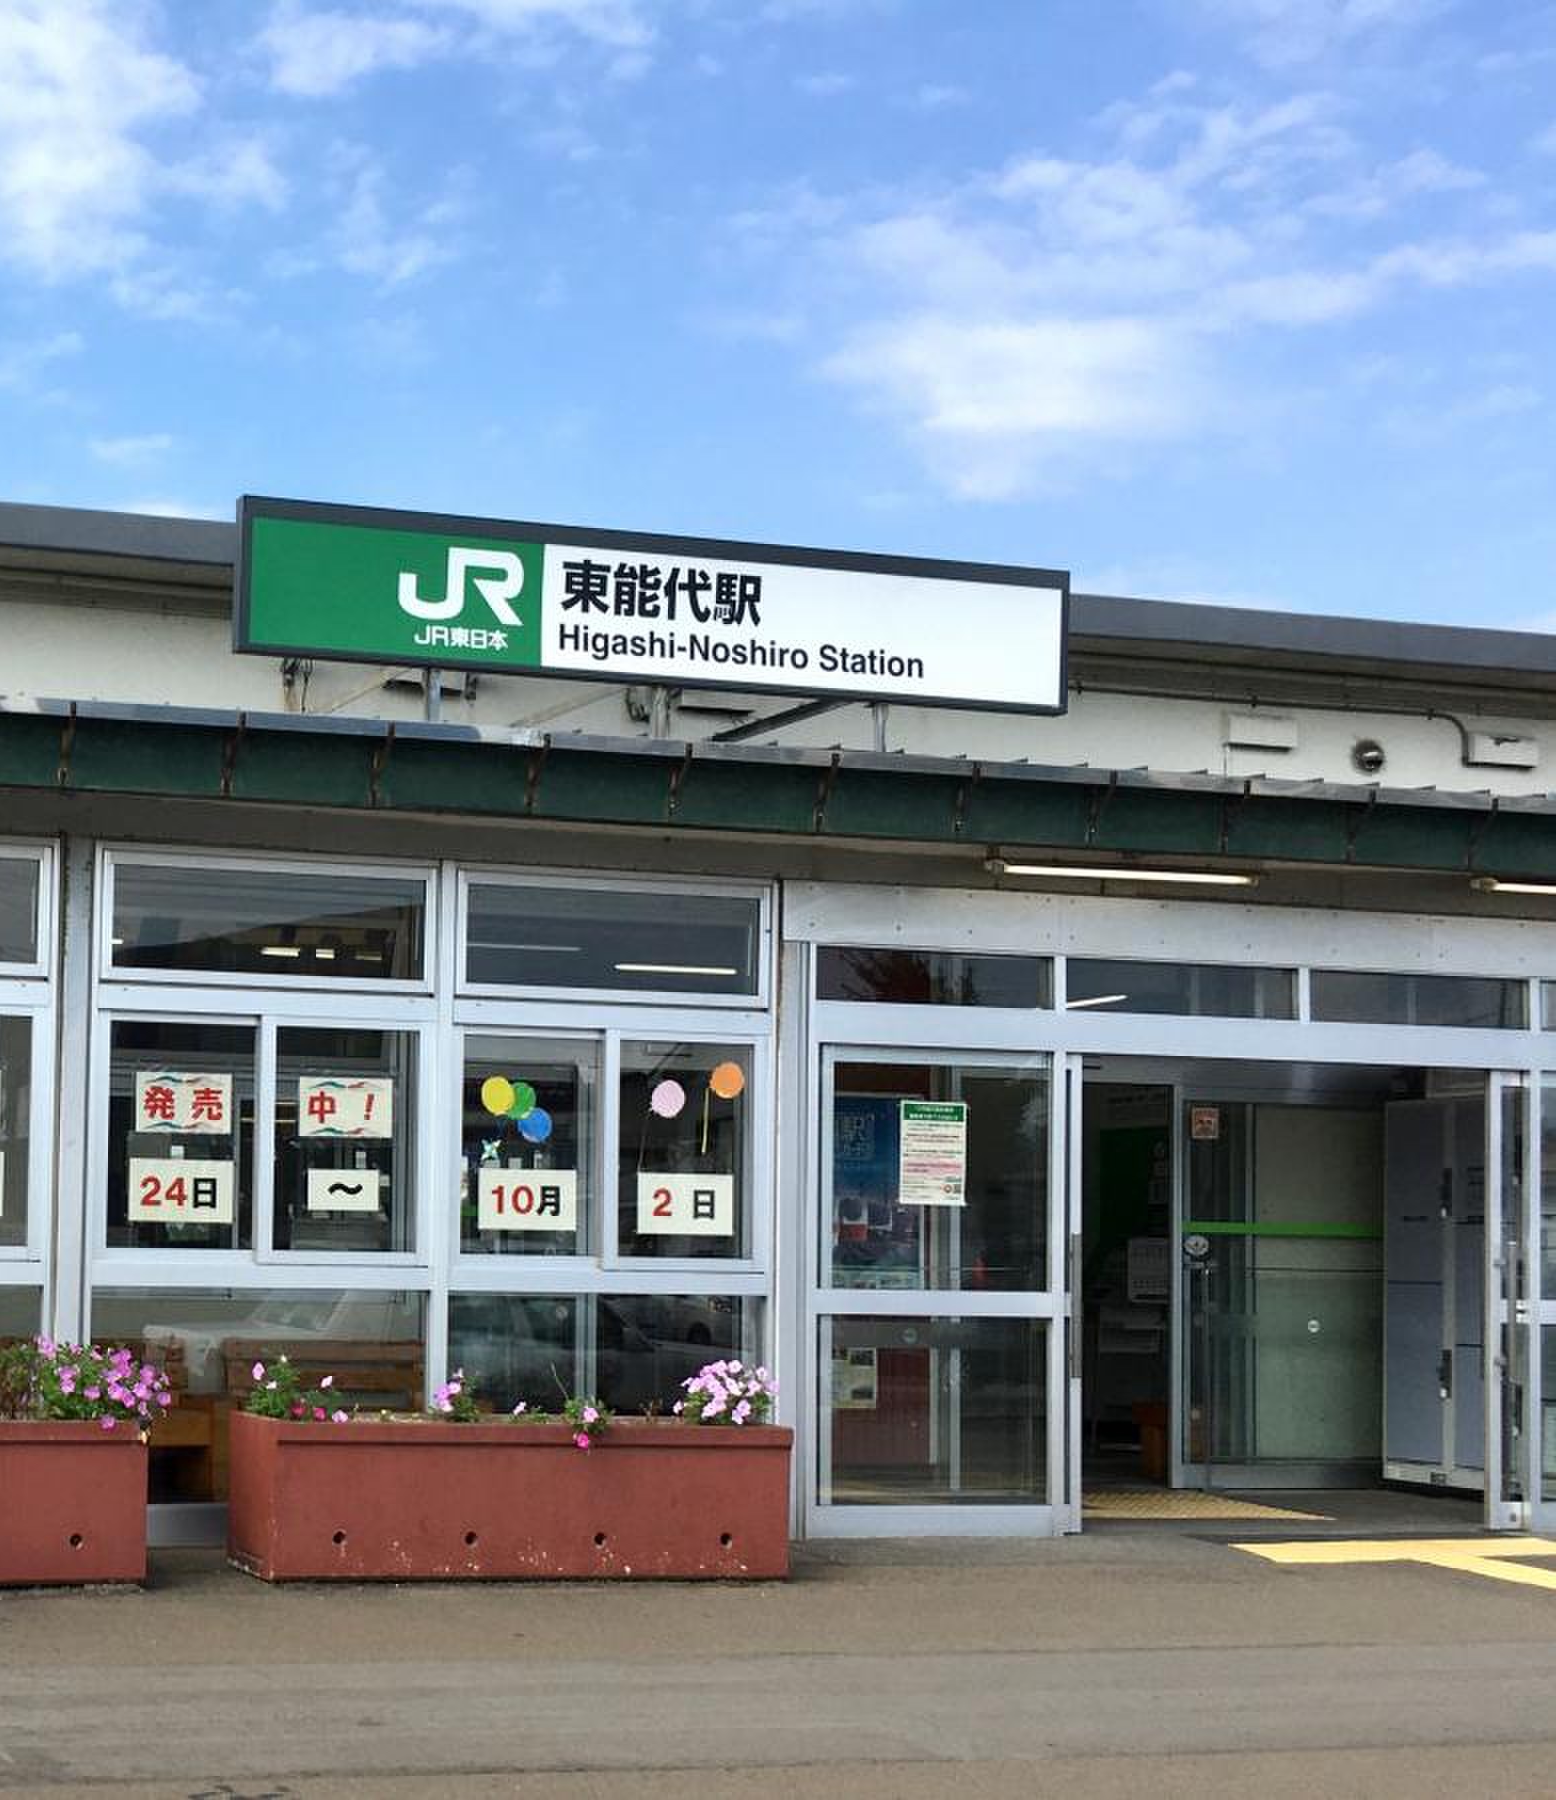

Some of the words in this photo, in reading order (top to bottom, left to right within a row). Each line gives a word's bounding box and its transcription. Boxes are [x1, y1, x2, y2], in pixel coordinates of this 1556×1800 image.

[398, 547, 525, 626] JR
[559, 559, 763, 626] 東能代駅
[414, 623, 509, 650] JR東日本
[559, 624, 809, 670] Higashi-Noshiro
[819, 645, 924, 678] Station
[140, 1176, 218, 1209] 24日
[491, 1185, 561, 1217] 10月
